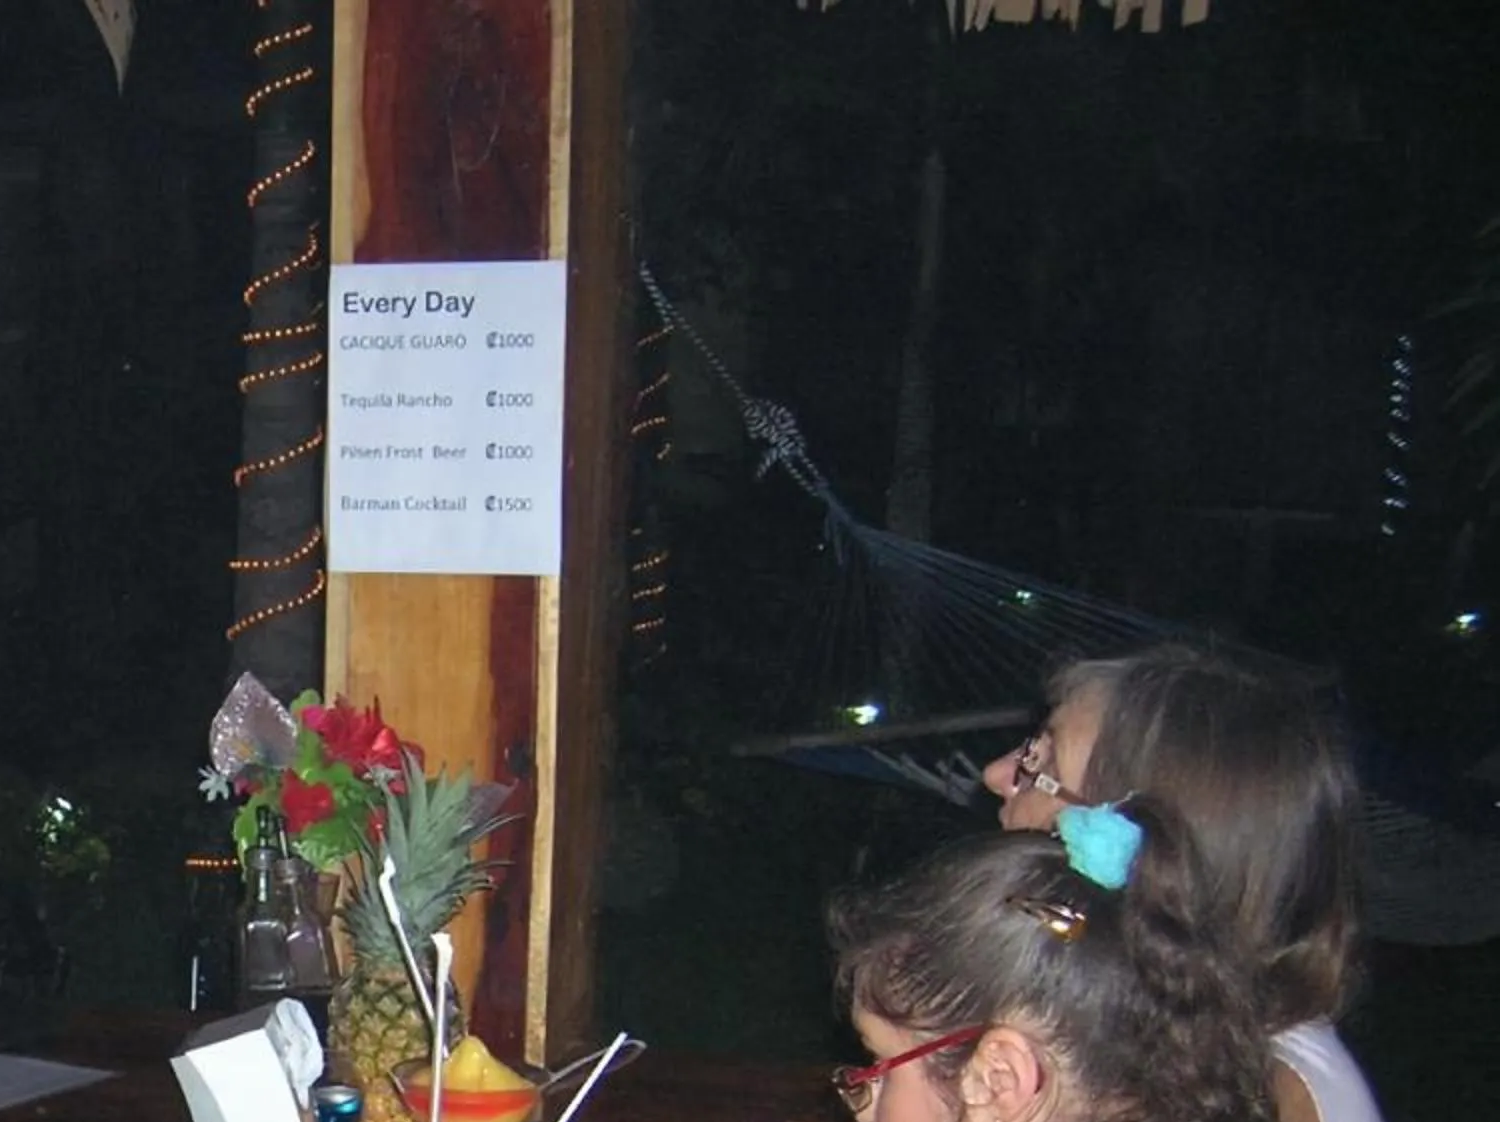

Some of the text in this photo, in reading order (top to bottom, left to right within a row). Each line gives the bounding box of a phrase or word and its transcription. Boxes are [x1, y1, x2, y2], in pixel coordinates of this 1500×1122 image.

[343, 290, 475, 319] Every Day
[339, 334, 406, 351] CACIQUE
[409, 333, 467, 350] GUARO
[340, 393, 393, 410] Tequila
[396, 393, 453, 408] Rancho
[340, 445, 383, 459] Pilsen
[385, 444, 424, 459] Frost
[432, 444, 467, 460] Beer
[340, 495, 401, 511] Barman
[404, 495, 467, 511] Cocktail
